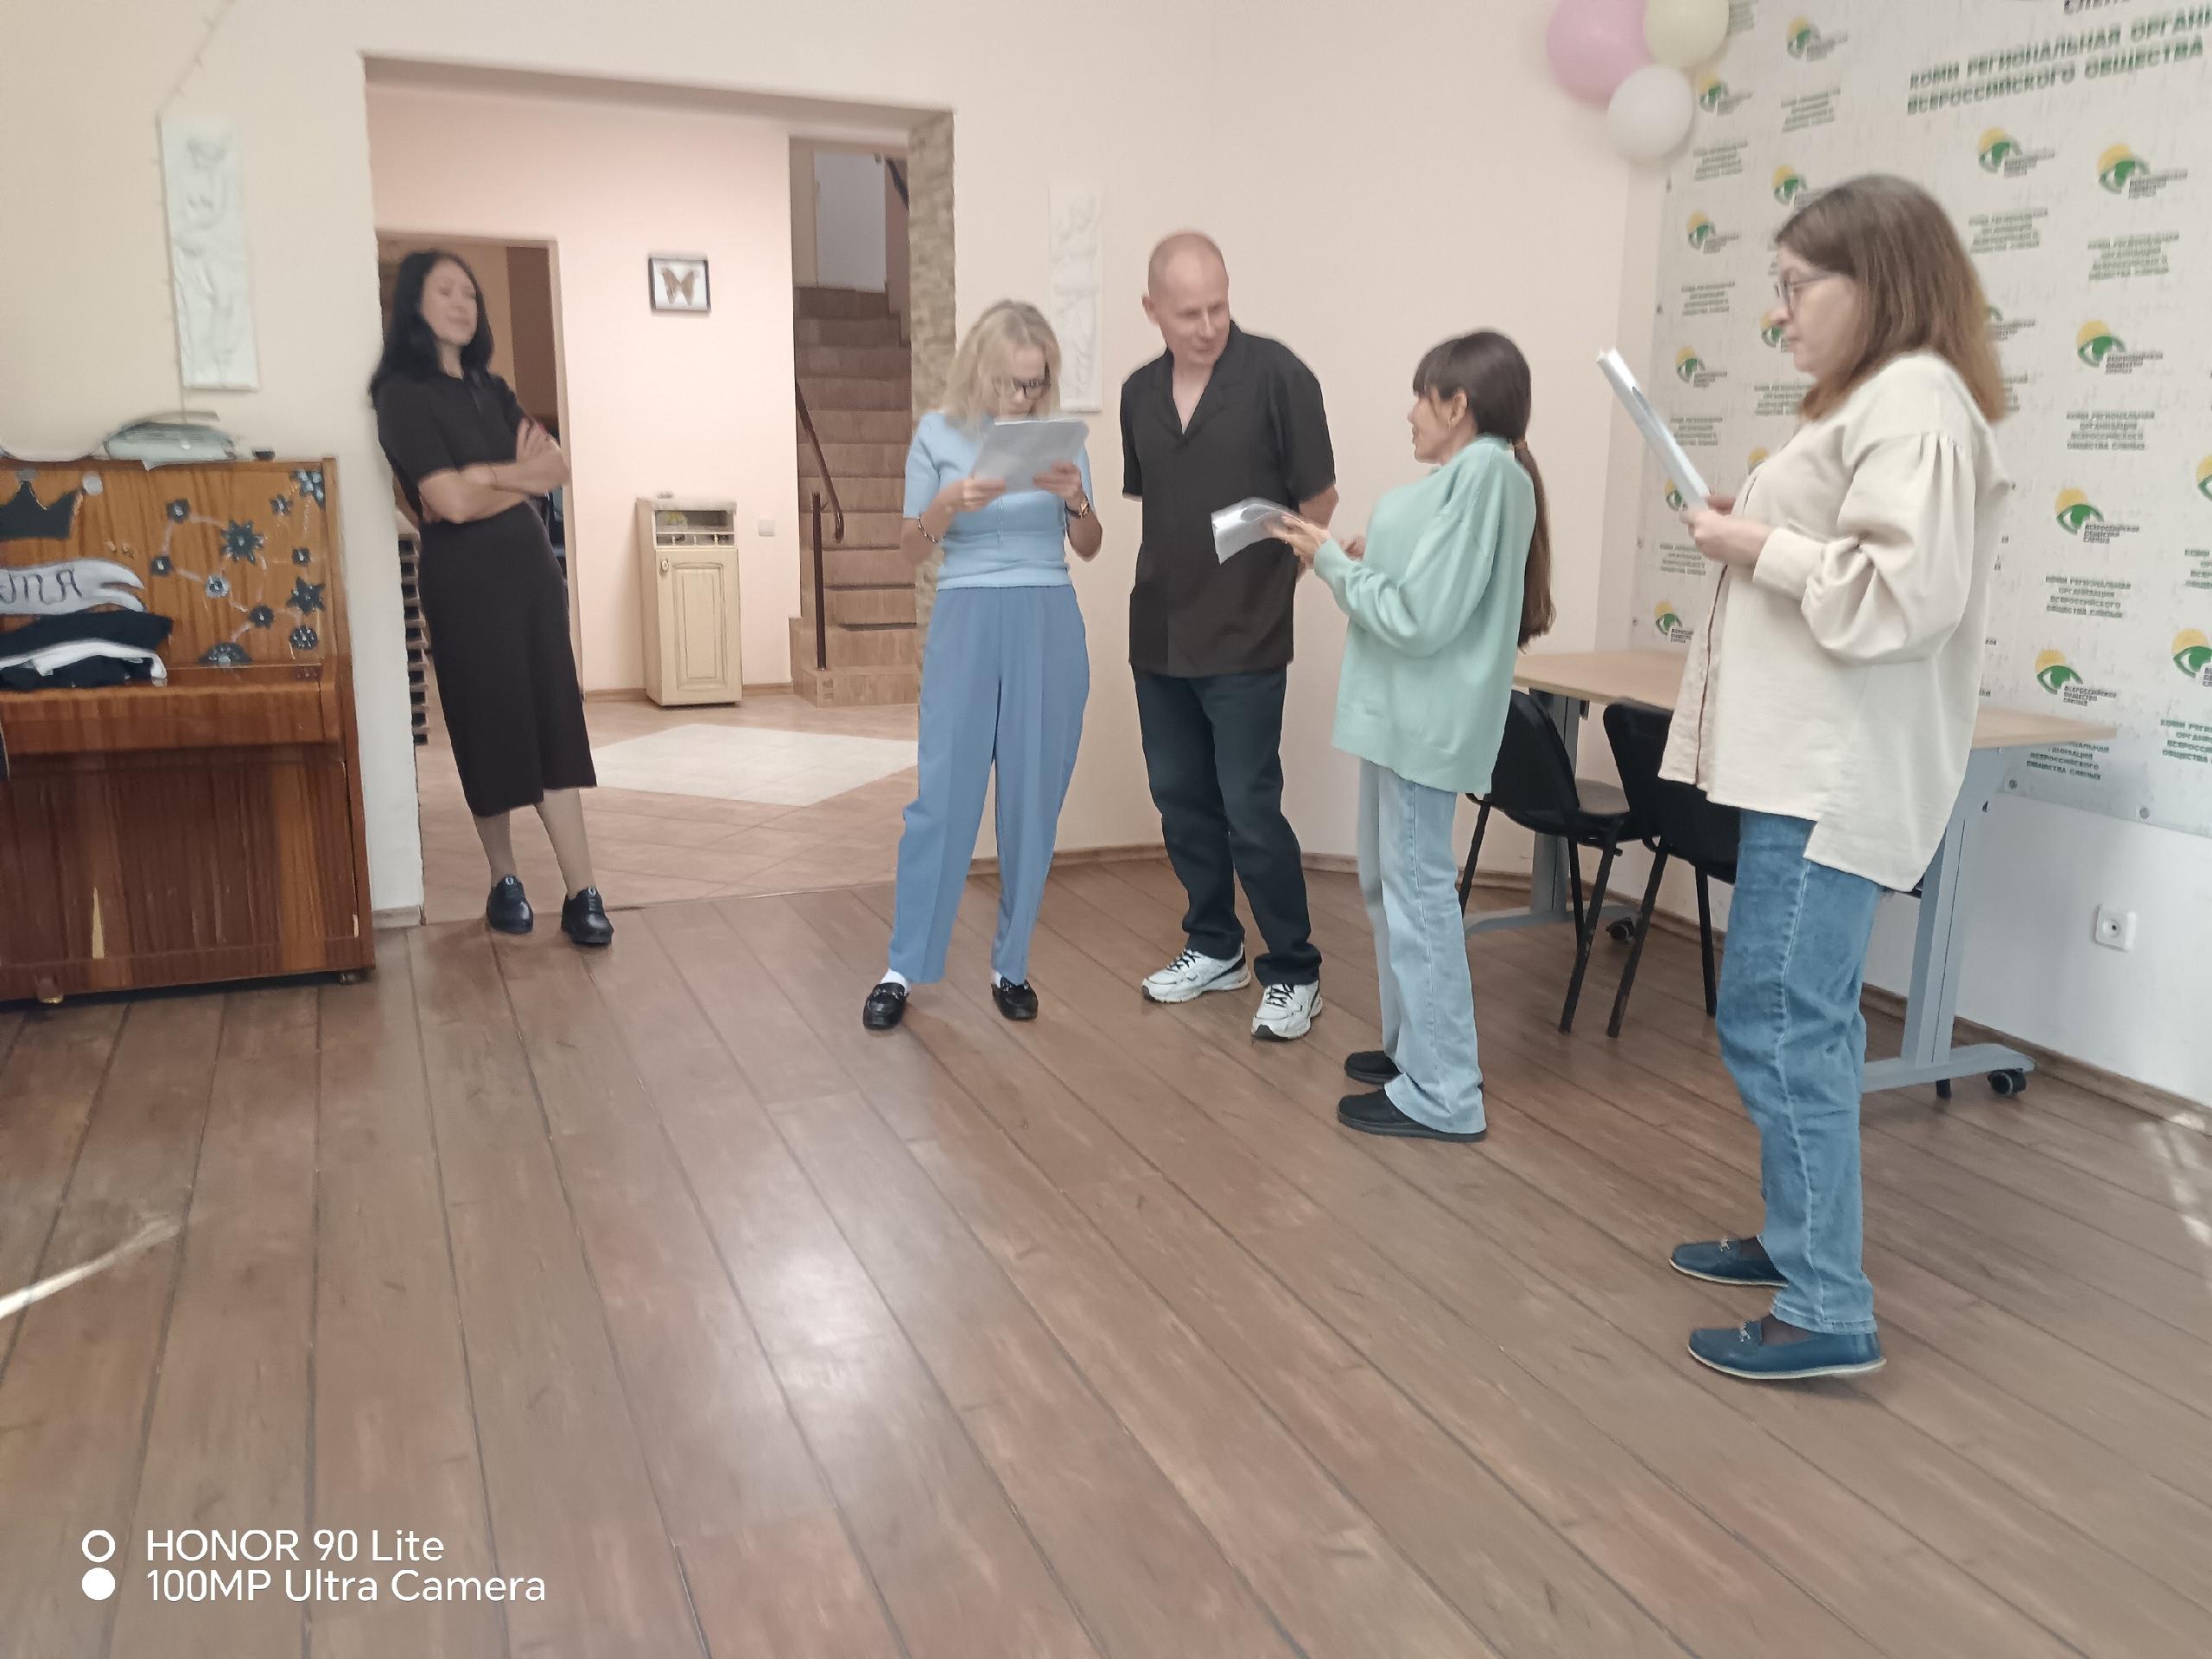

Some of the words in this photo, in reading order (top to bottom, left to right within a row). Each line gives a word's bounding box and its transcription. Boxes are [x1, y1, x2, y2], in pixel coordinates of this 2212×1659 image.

[1910, 63, 1959, 89] КОМИ
[1967, 23, 2121, 76] РЕГИОНАЛЬНАЯ
[2084, 35, 2202, 79] ОБЩЕСТВА
